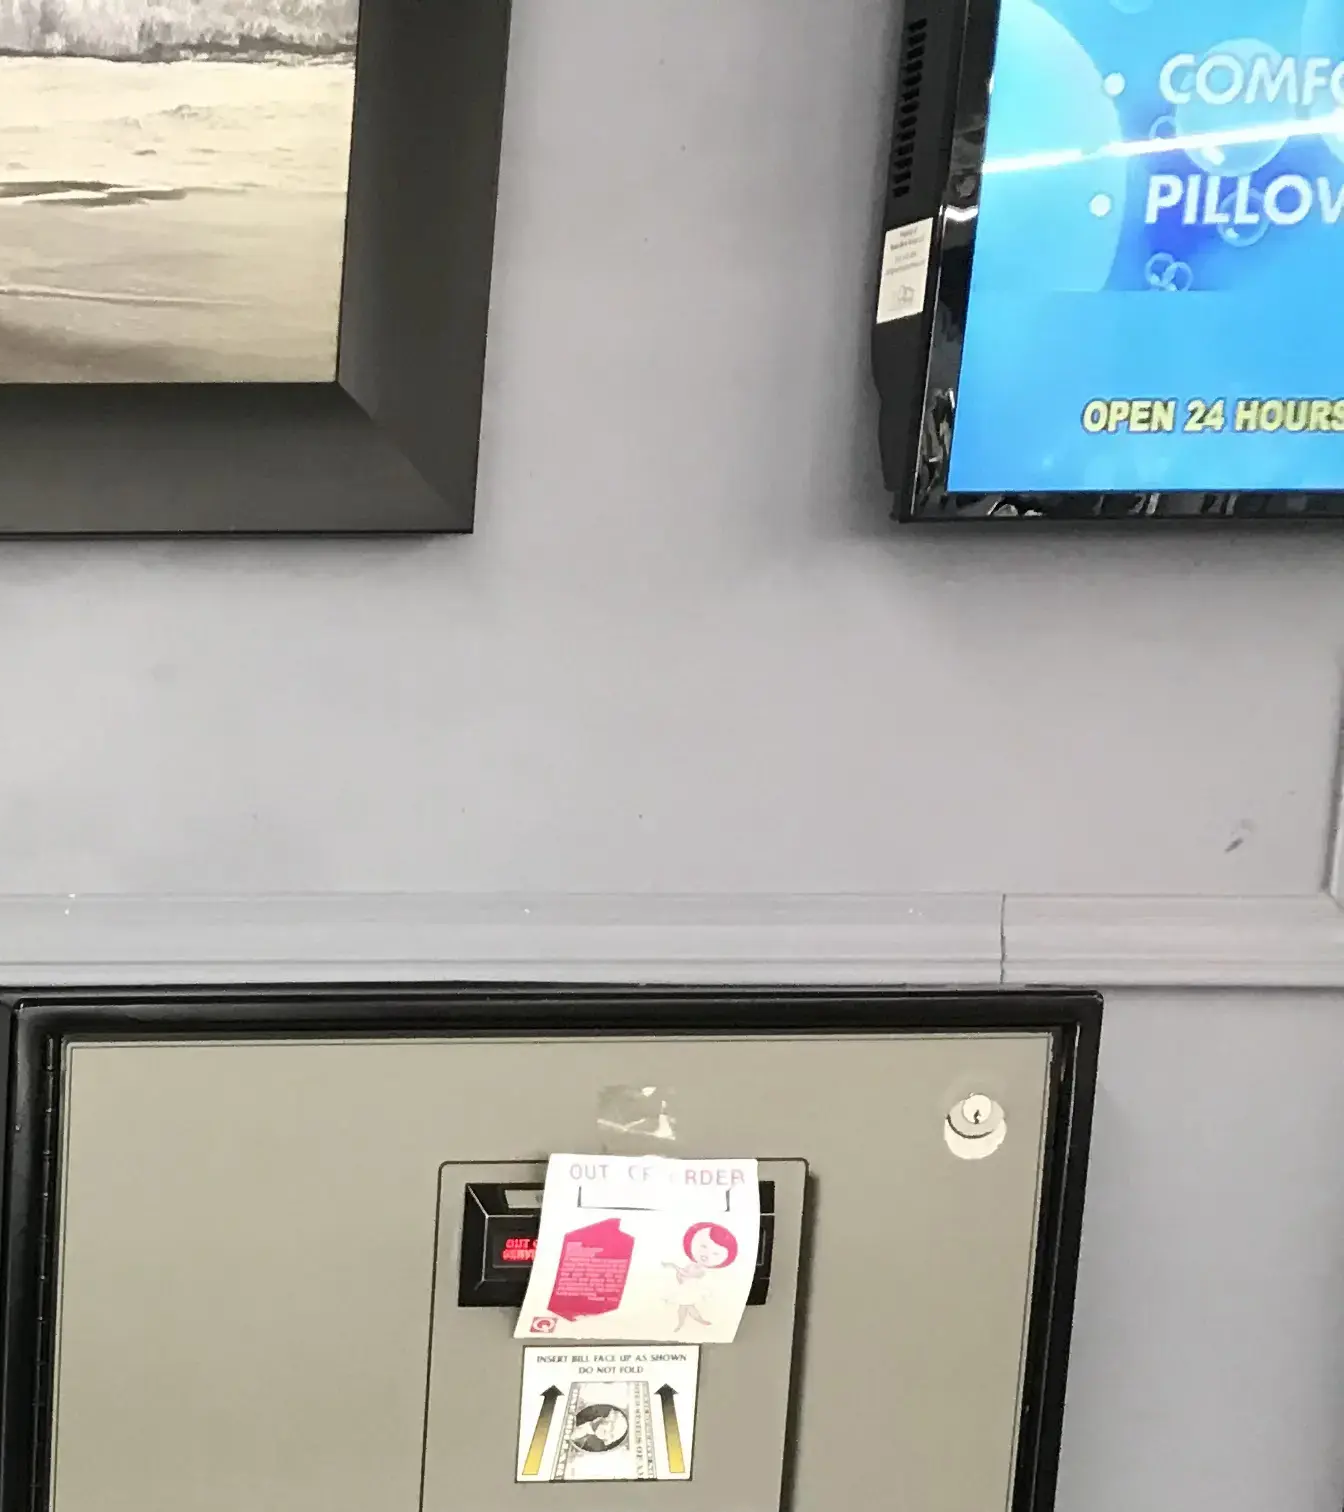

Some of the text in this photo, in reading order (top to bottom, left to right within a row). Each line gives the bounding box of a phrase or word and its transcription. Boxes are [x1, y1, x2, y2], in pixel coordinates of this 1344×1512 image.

[1159, 53, 1344, 105] COMF
[1081, 398, 1344, 433] OPEN 24 HOURS
[569, 1163, 609, 1181] OUT
[669, 1168, 746, 1187] RDER
[536, 1355, 568, 1363] INSERT
[571, 1355, 590, 1363] BILL
[593, 1355, 616, 1363] FACE
[651, 1354, 687, 1362] SHOWN
[578, 1366, 644, 1374] DO NOT FOLD
